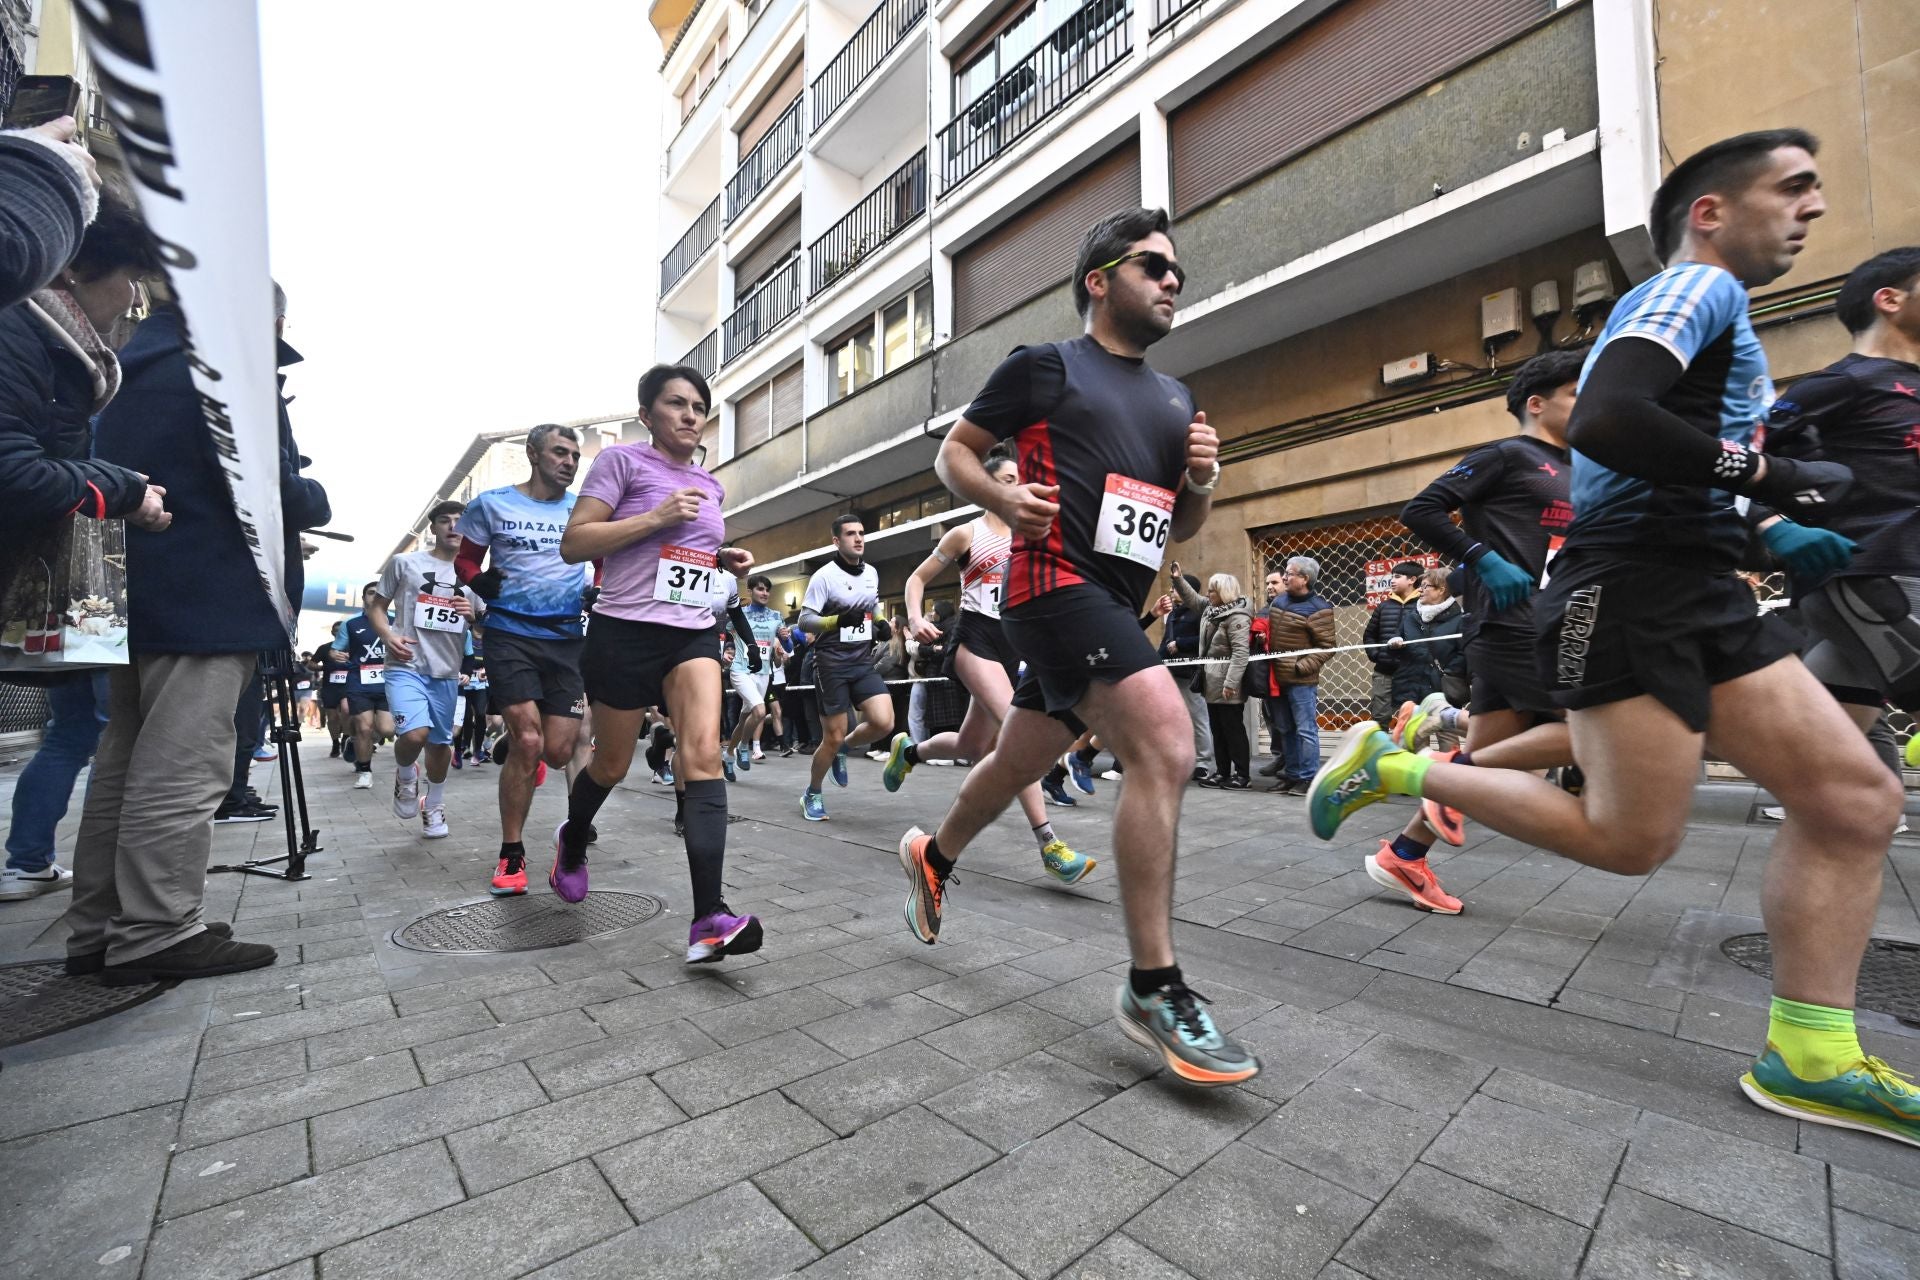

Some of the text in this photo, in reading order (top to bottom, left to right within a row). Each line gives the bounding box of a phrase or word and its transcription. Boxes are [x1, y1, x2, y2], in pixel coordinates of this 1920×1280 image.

[1113, 504, 1169, 549] 366
[667, 565, 710, 593] 371
[1368, 556, 1435, 574] SE VDE
[424, 606, 460, 624] 155
[1557, 585, 1602, 688] TERREX
